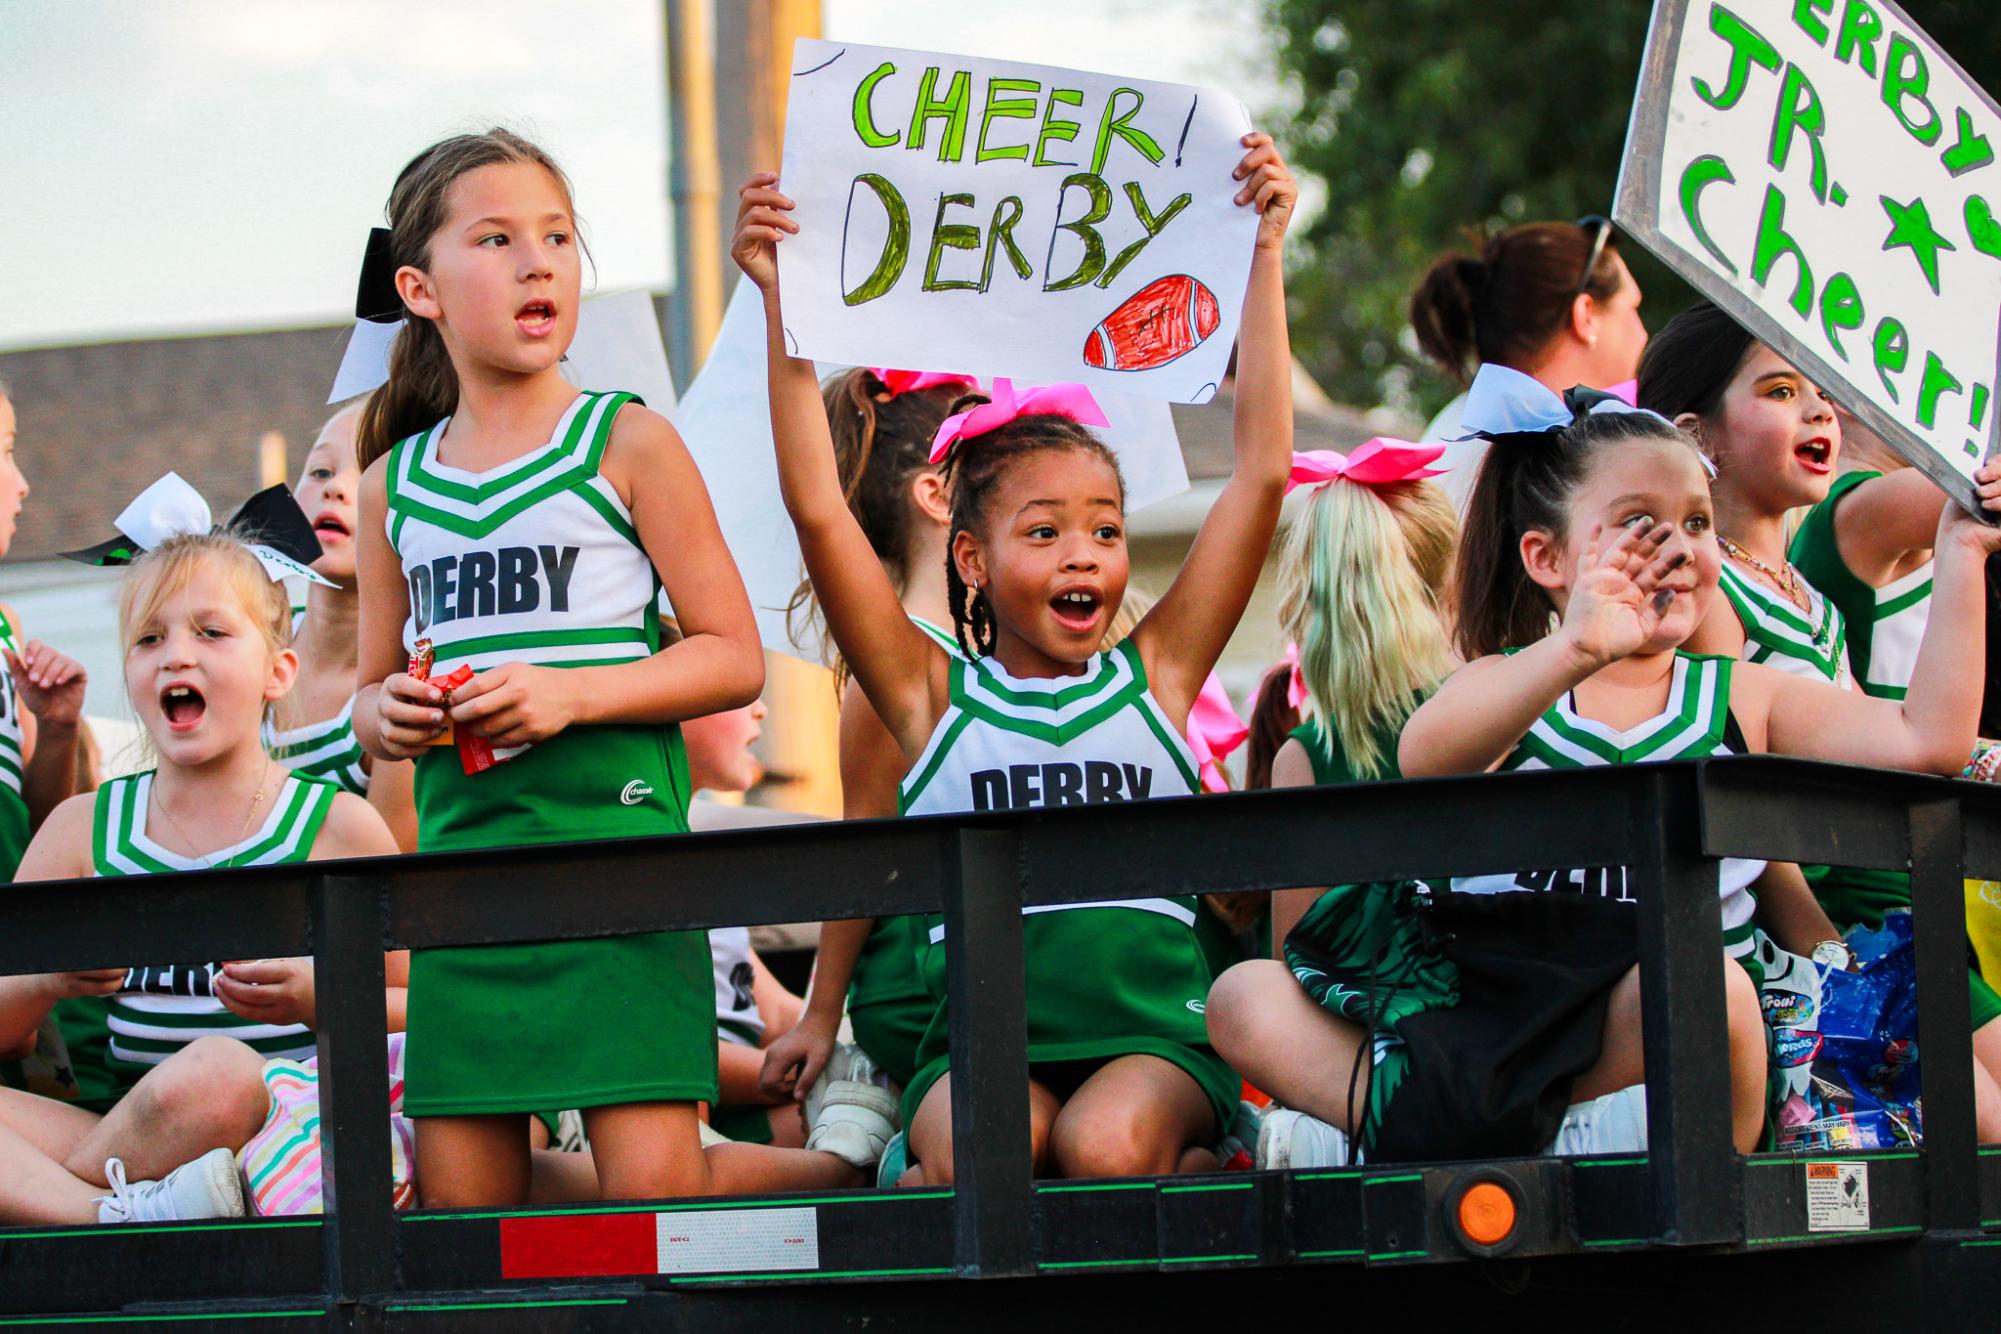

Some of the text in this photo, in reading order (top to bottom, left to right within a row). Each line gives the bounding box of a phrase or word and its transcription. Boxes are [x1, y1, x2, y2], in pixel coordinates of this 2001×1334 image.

[852, 61, 1198, 176] CHEER!
[1691, 3, 1849, 207] JR.
[841, 172, 1193, 306] DERBY
[1678, 154, 1990, 458] Cheer!
[408, 545, 580, 636] DERBY
